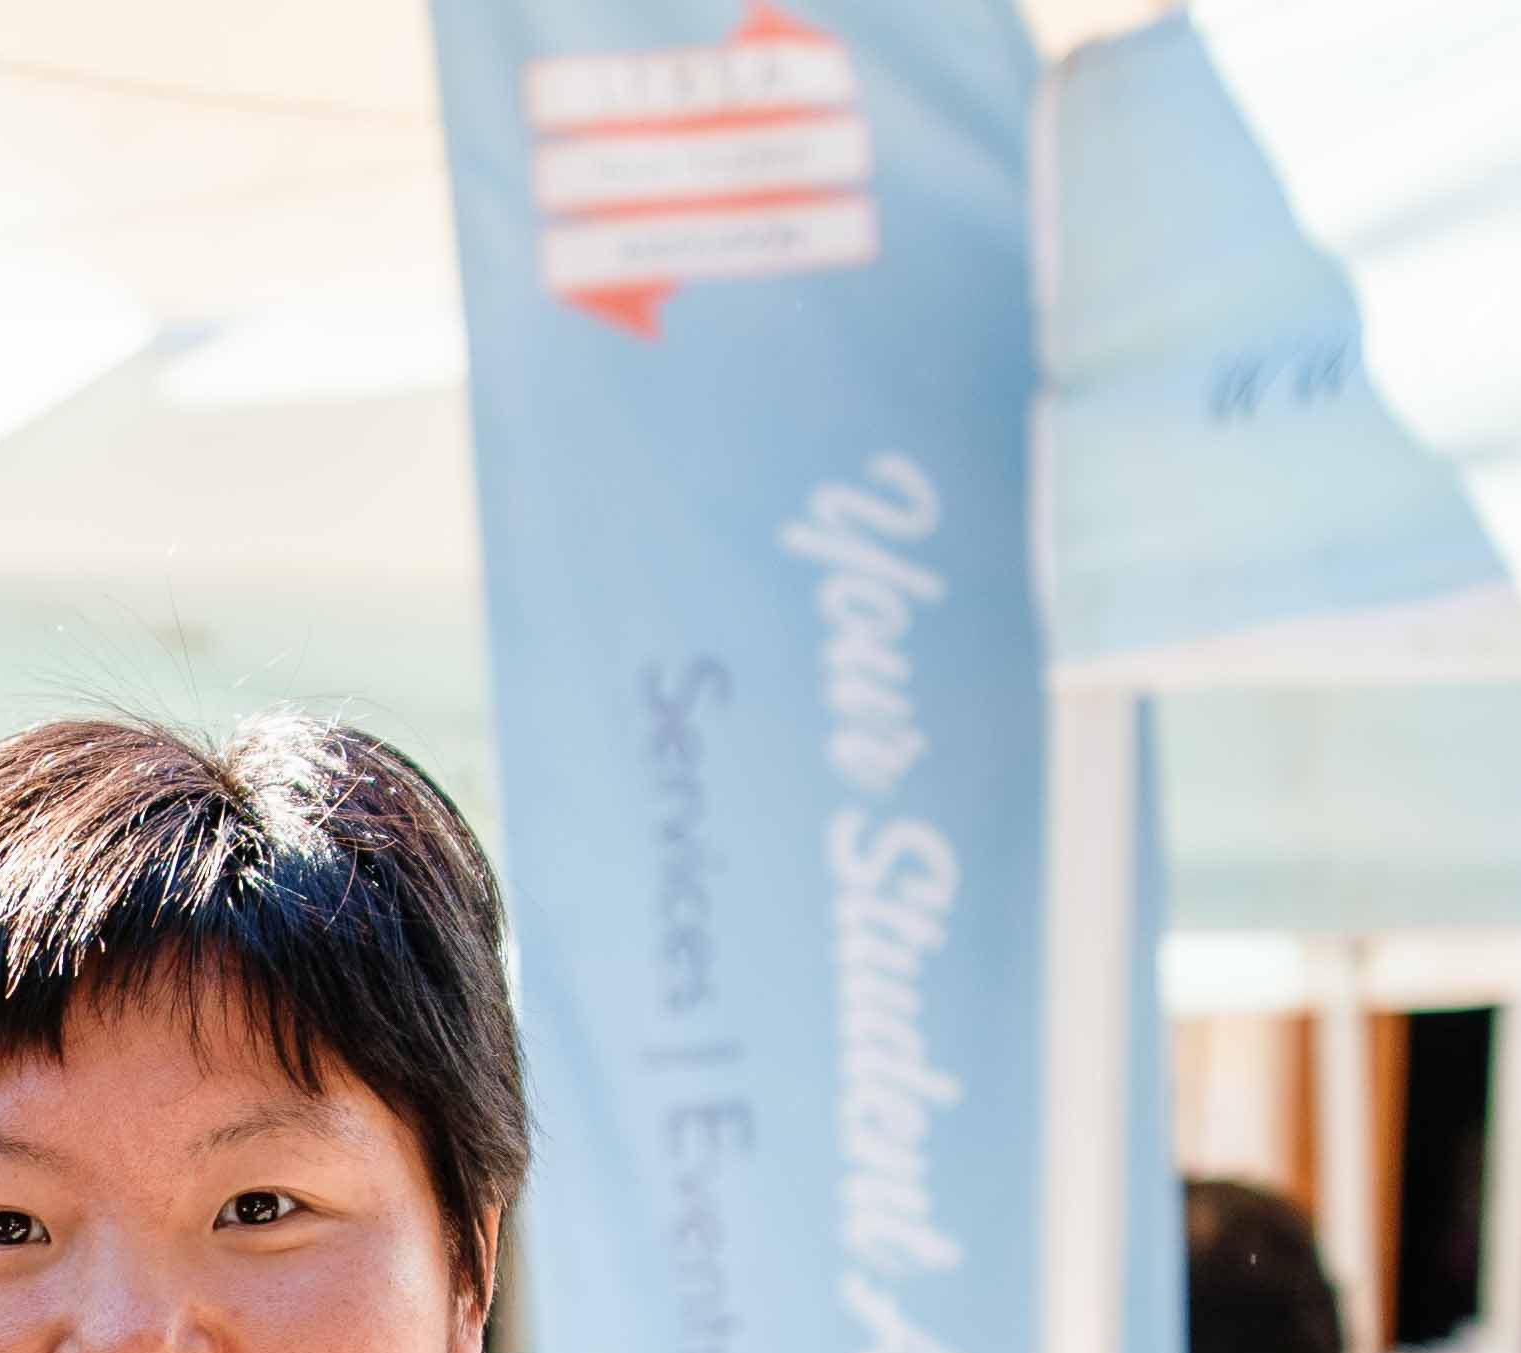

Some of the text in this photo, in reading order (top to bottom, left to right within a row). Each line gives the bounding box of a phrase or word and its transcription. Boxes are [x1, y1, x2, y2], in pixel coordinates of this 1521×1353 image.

[778, 450, 948, 793] Your
[637, 649, 736, 1017] Services
[828, 806, 961, 1274] Student
